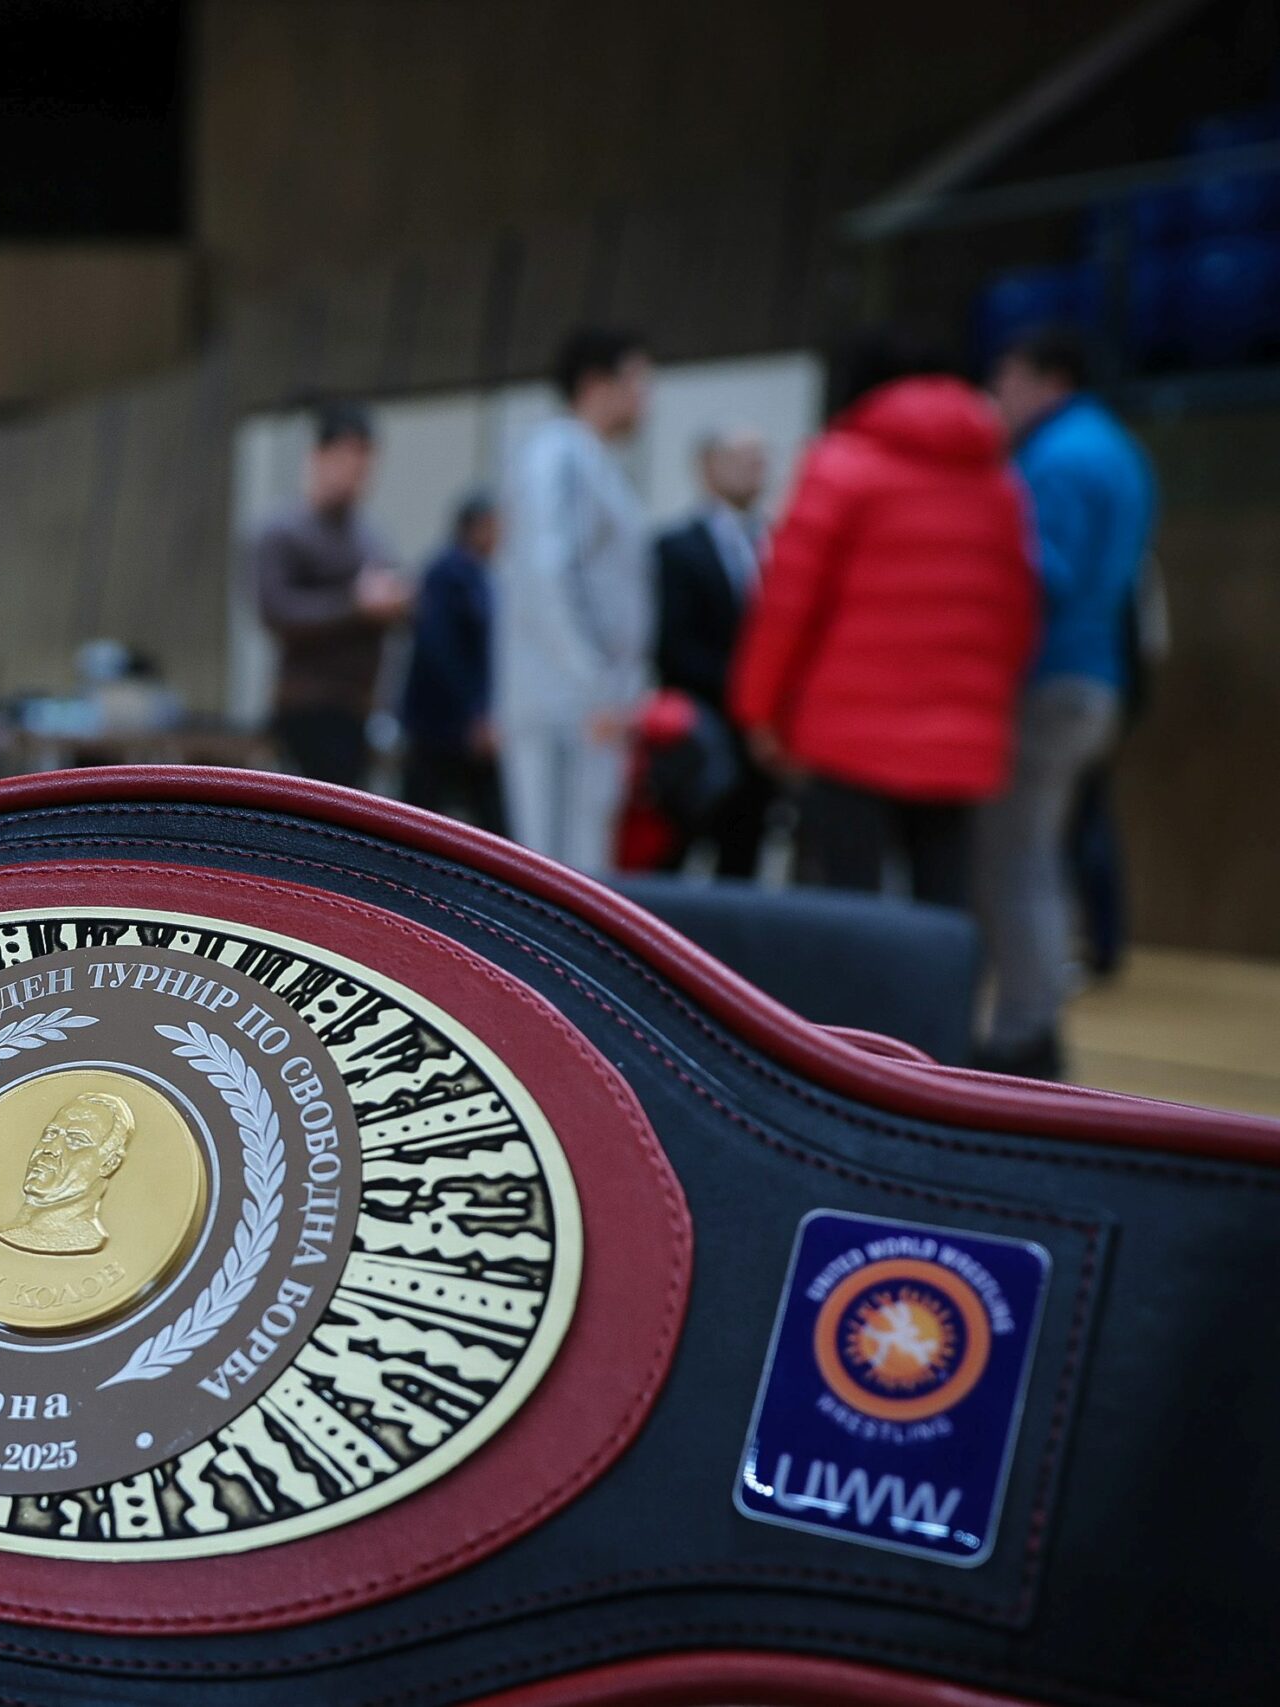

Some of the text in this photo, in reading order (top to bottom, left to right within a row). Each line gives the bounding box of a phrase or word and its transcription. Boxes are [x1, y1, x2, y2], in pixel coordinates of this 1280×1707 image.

[87, 962, 239, 1015] ТУРНИР
[232, 1003, 291, 1056] ПО
[280, 1056, 342, 1267] СВОБОДНА
[8, 1261, 126, 1310] КОЛОВ
[197, 1277, 312, 1401] БОРБА
[773, 1453, 963, 1539] UWW
